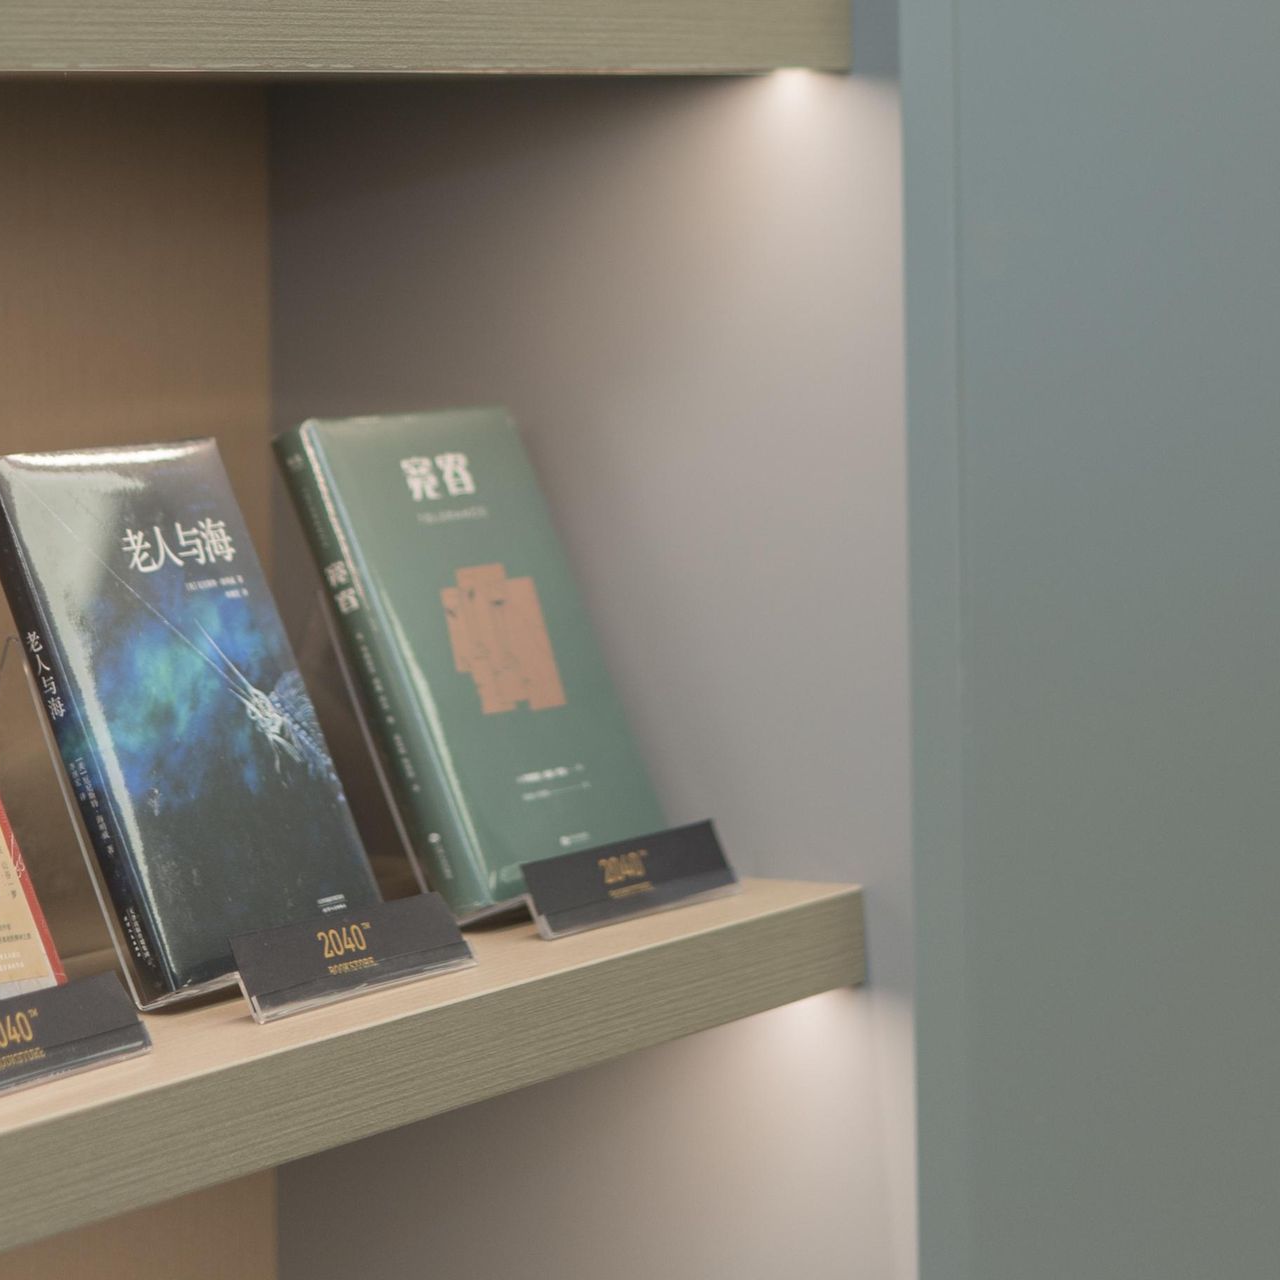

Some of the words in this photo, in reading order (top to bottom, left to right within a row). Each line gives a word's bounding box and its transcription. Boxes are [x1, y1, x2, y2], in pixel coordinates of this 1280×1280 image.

[121, 517, 236, 573] 老人与海
[26, 631, 65, 720] 老人与海
